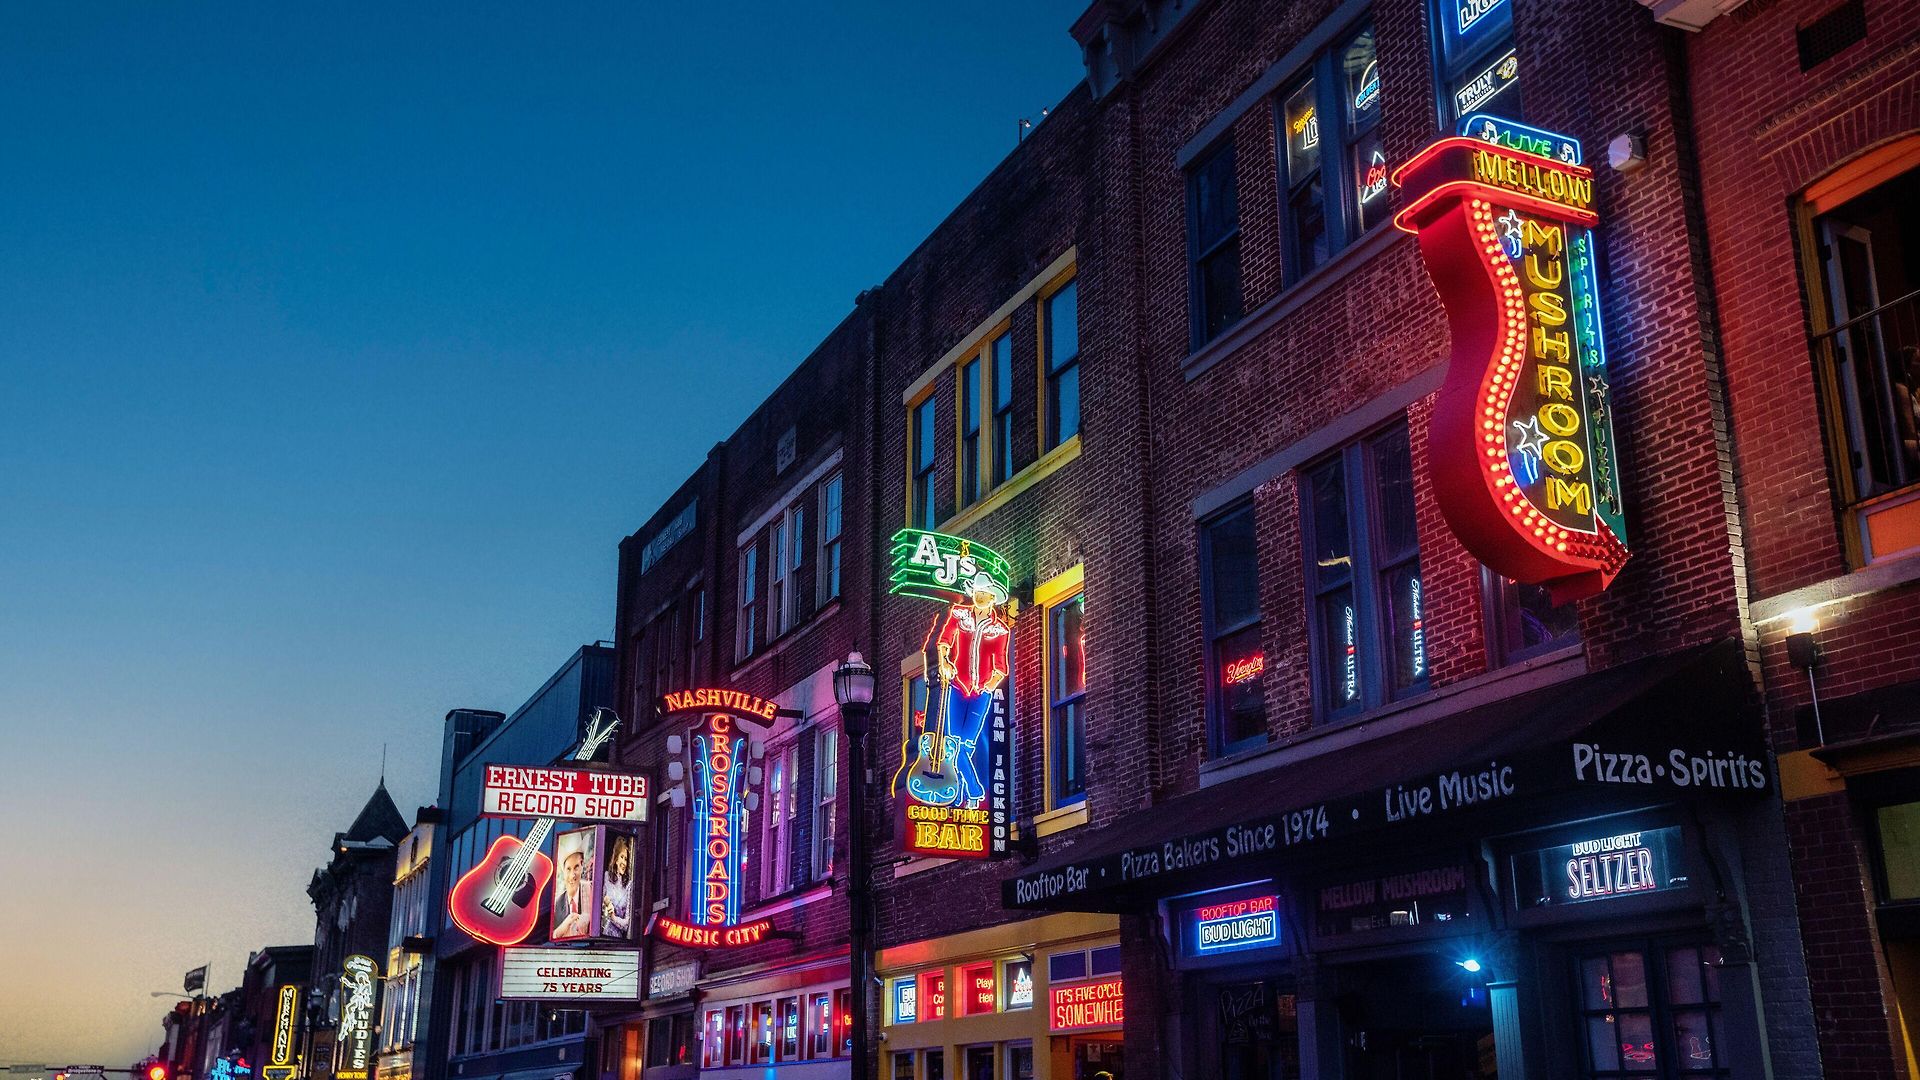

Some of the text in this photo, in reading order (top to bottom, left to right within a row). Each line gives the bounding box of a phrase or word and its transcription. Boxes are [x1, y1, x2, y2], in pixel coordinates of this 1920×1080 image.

[1458, 71, 1492, 105] TRULY
[1502, 130, 1551, 158] LIVE
[1473, 150, 1592, 209] MELLOW
[1578, 238, 1598, 364] SPIRITS
[1521, 220, 1591, 515] MUSHROOM
[1413, 629, 1424, 676] ULTRA
[1346, 654, 1356, 700] ULTRA
[664, 688, 778, 720] NASHVILLE
[487, 766, 646, 796] ERNEST TUBB
[993, 688, 1006, 852] ALAN JACKSON
[1573, 743, 1766, 789] Pizza Spirits
[498, 792, 635, 818] RECORD SHOP
[706, 713, 732, 924] CROSSROADS
[915, 822, 984, 851] BAR
[1016, 761, 1514, 904] Rooftop Bar Pizza Bakers Since 1974 Live Music
[1572, 832, 1642, 857] BUD LIGHT
[1320, 866, 1466, 910] MELLOW MUSHROOM
[1566, 847, 1656, 898] SELTZER
[1202, 898, 1273, 921] ROOFTOP BAR
[1202, 916, 1272, 944] BUD LIGHT
[536, 967, 612, 978] CELEBRATING
[543, 983, 603, 993] 75 YEARS
[1056, 989, 1073, 1004] IT'S
[1075, 986, 1096, 1001] FIVE
[276, 989, 293, 1062] MERCHANTS
[352, 1010, 370, 1069] NUDIES
